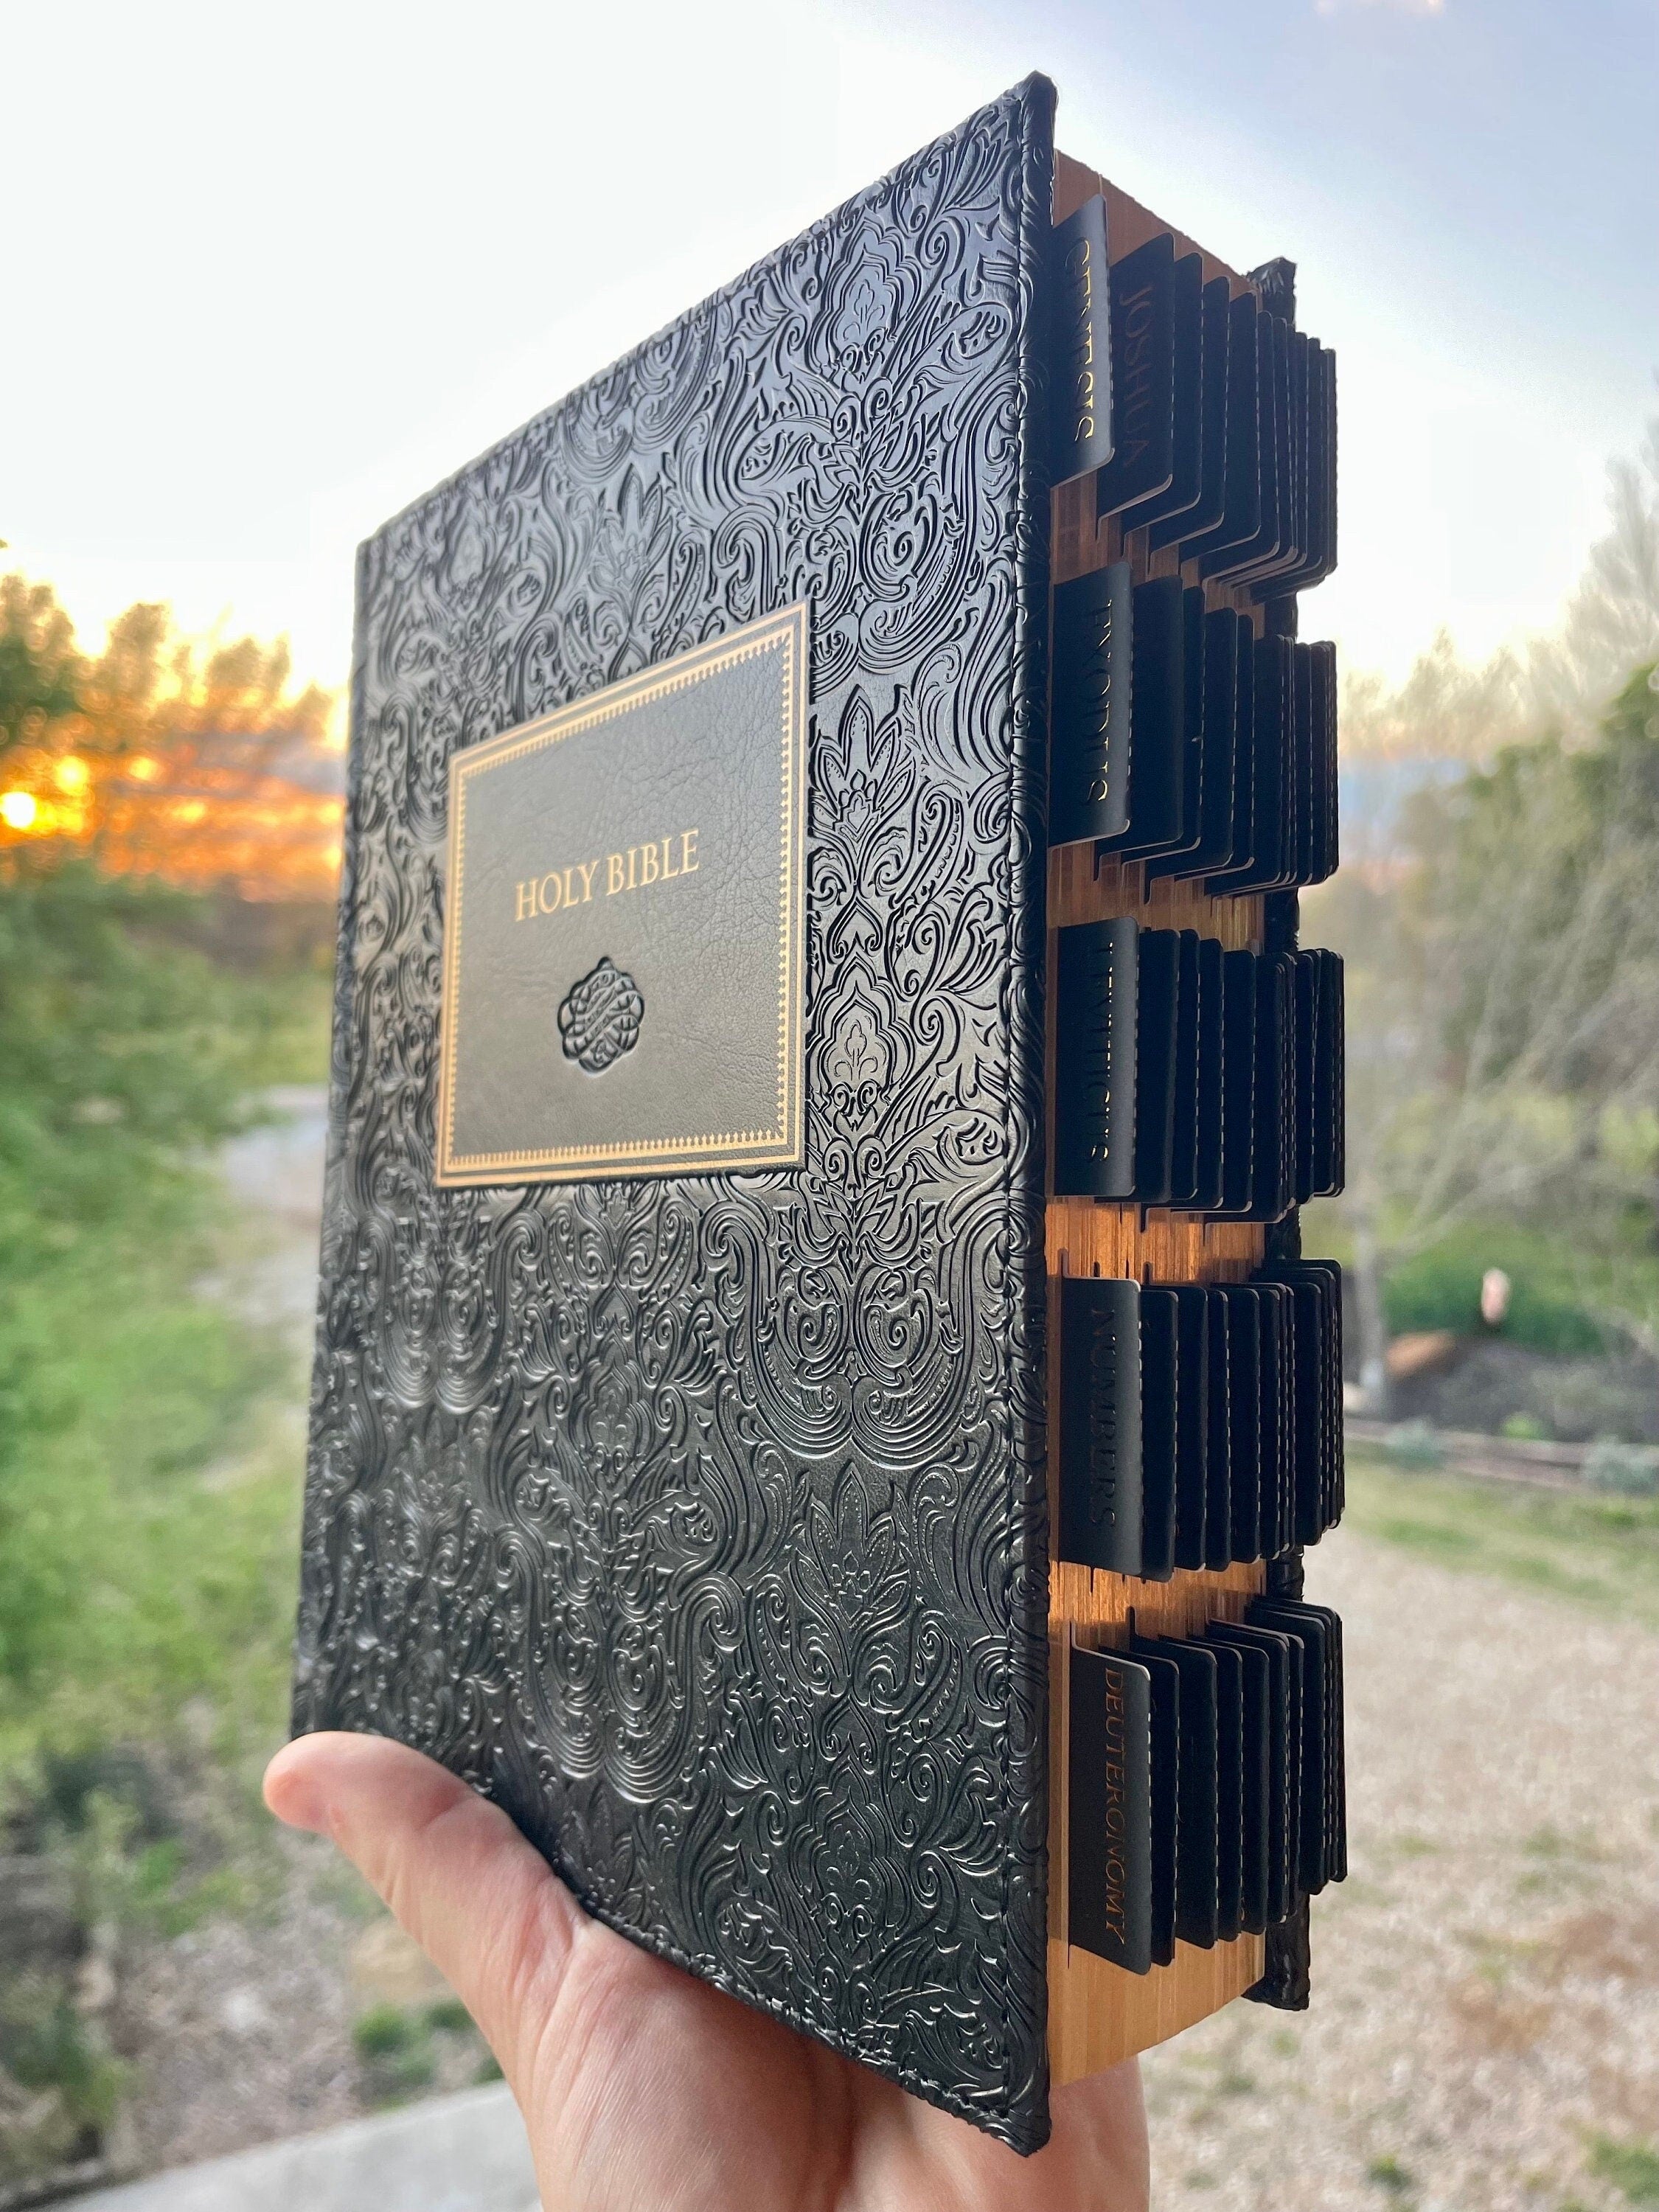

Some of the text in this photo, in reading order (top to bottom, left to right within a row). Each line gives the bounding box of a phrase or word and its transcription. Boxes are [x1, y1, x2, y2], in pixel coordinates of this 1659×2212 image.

[1064, 237, 1095, 443] GENESIS
[1119, 286, 1153, 467] JOSHUA
[1081, 599, 1113, 804] EXODUS
[515, 829, 700, 922] HOLY BIBLE
[1091, 1308, 1116, 1528] NUMBERS
[1105, 1667, 1126, 1945] DEUTERONOMY
